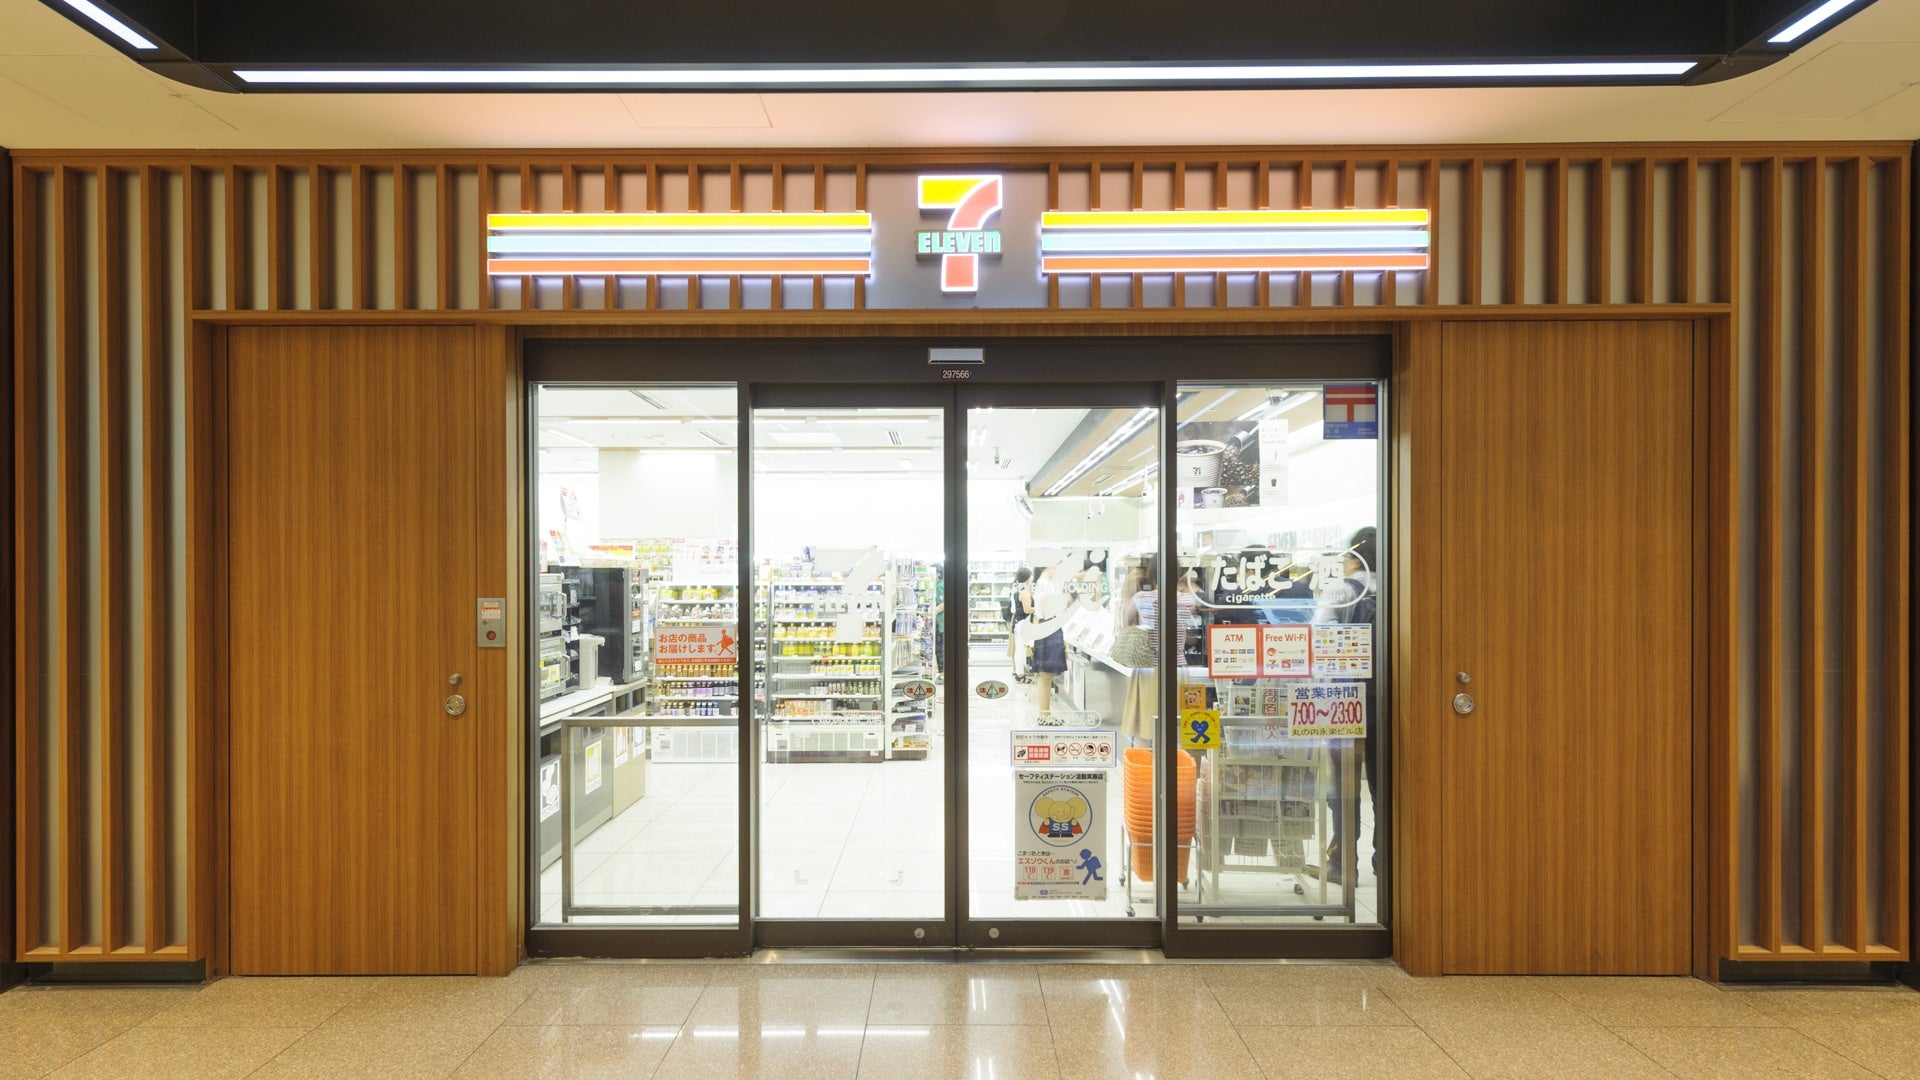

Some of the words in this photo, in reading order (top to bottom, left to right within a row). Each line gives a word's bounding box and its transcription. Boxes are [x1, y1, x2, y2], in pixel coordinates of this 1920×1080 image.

[918, 175, 1002, 291] 7
[942, 370, 970, 379] 297566
[1211, 554, 1293, 591] たばこ
[1308, 556, 1345, 591] 酒
[1225, 593, 1276, 604] cigarette
[659, 633, 707, 643] お店の商品
[1224, 634, 1244, 642] ATM
[1265, 633, 1283, 642] Free
[1284, 633, 1307, 642] Wi-Fi
[1295, 686, 1359, 700] 営業時間
[1052, 823, 1069, 831] SS
[1025, 866, 1036, 874] 110
